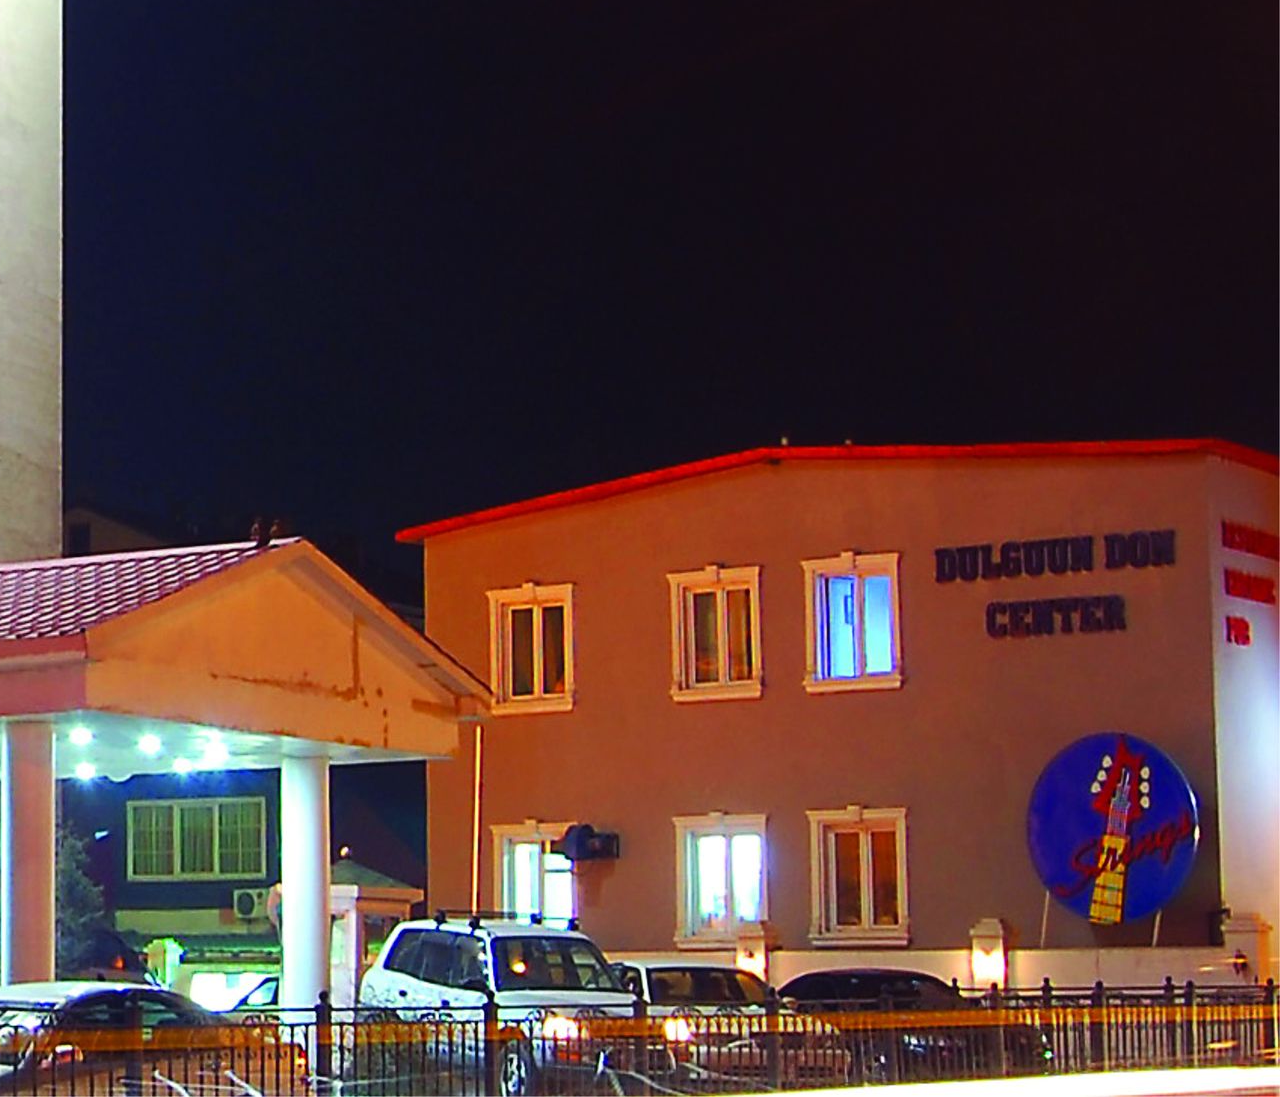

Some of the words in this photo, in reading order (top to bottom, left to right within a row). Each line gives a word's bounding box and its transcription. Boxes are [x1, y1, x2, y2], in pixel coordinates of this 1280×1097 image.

[935, 536, 1094, 583] DULGUUN
[1105, 530, 1176, 570] DON
[986, 595, 1127, 638] CENTER
